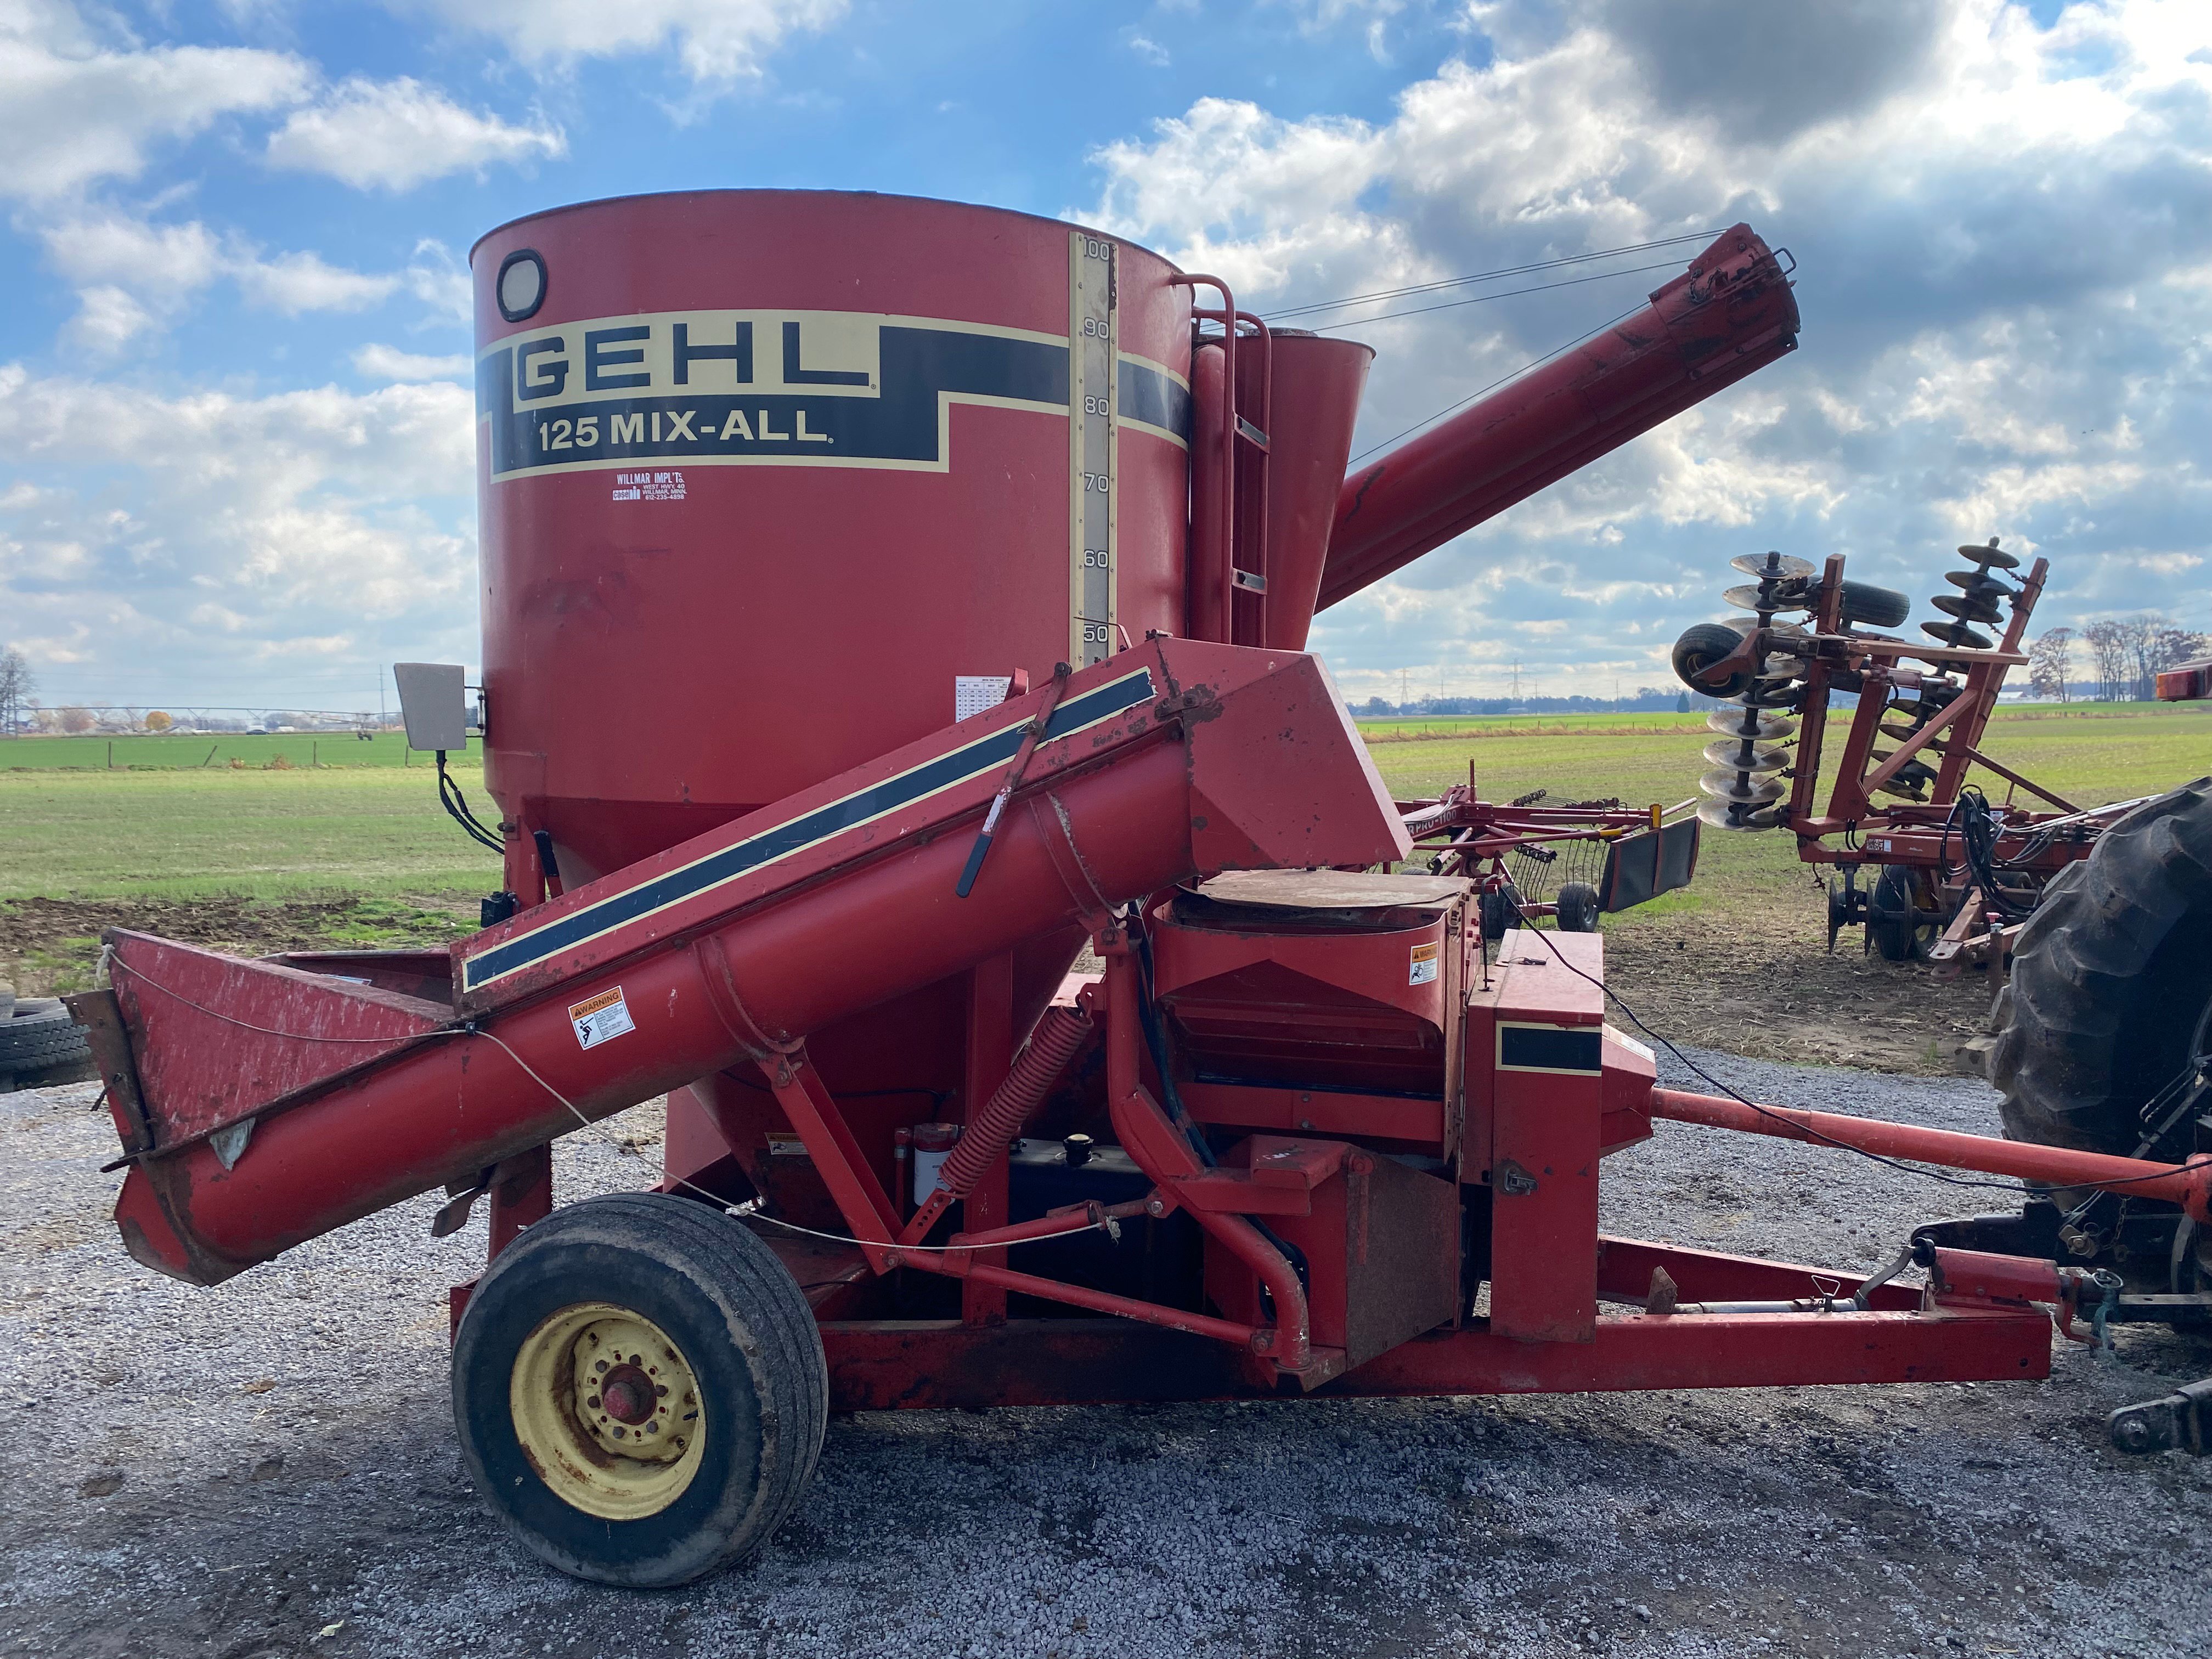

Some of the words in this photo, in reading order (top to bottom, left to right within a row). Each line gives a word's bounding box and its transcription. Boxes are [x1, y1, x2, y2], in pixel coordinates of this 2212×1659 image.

[1084, 237, 1110, 261] 100
[1084, 317, 1109, 340] 90
[517, 321, 870, 401] GEHL
[1084, 395, 1109, 416] 80
[539, 416, 599, 452] 125
[611, 410, 827, 444] MIX-ALL
[617, 472, 651, 484] WILLMAR
[1084, 472, 1109, 493] 70
[1084, 549, 1109, 568] 60
[1084, 624, 1109, 643] 50
[580, 992, 619, 1014] WARNING
